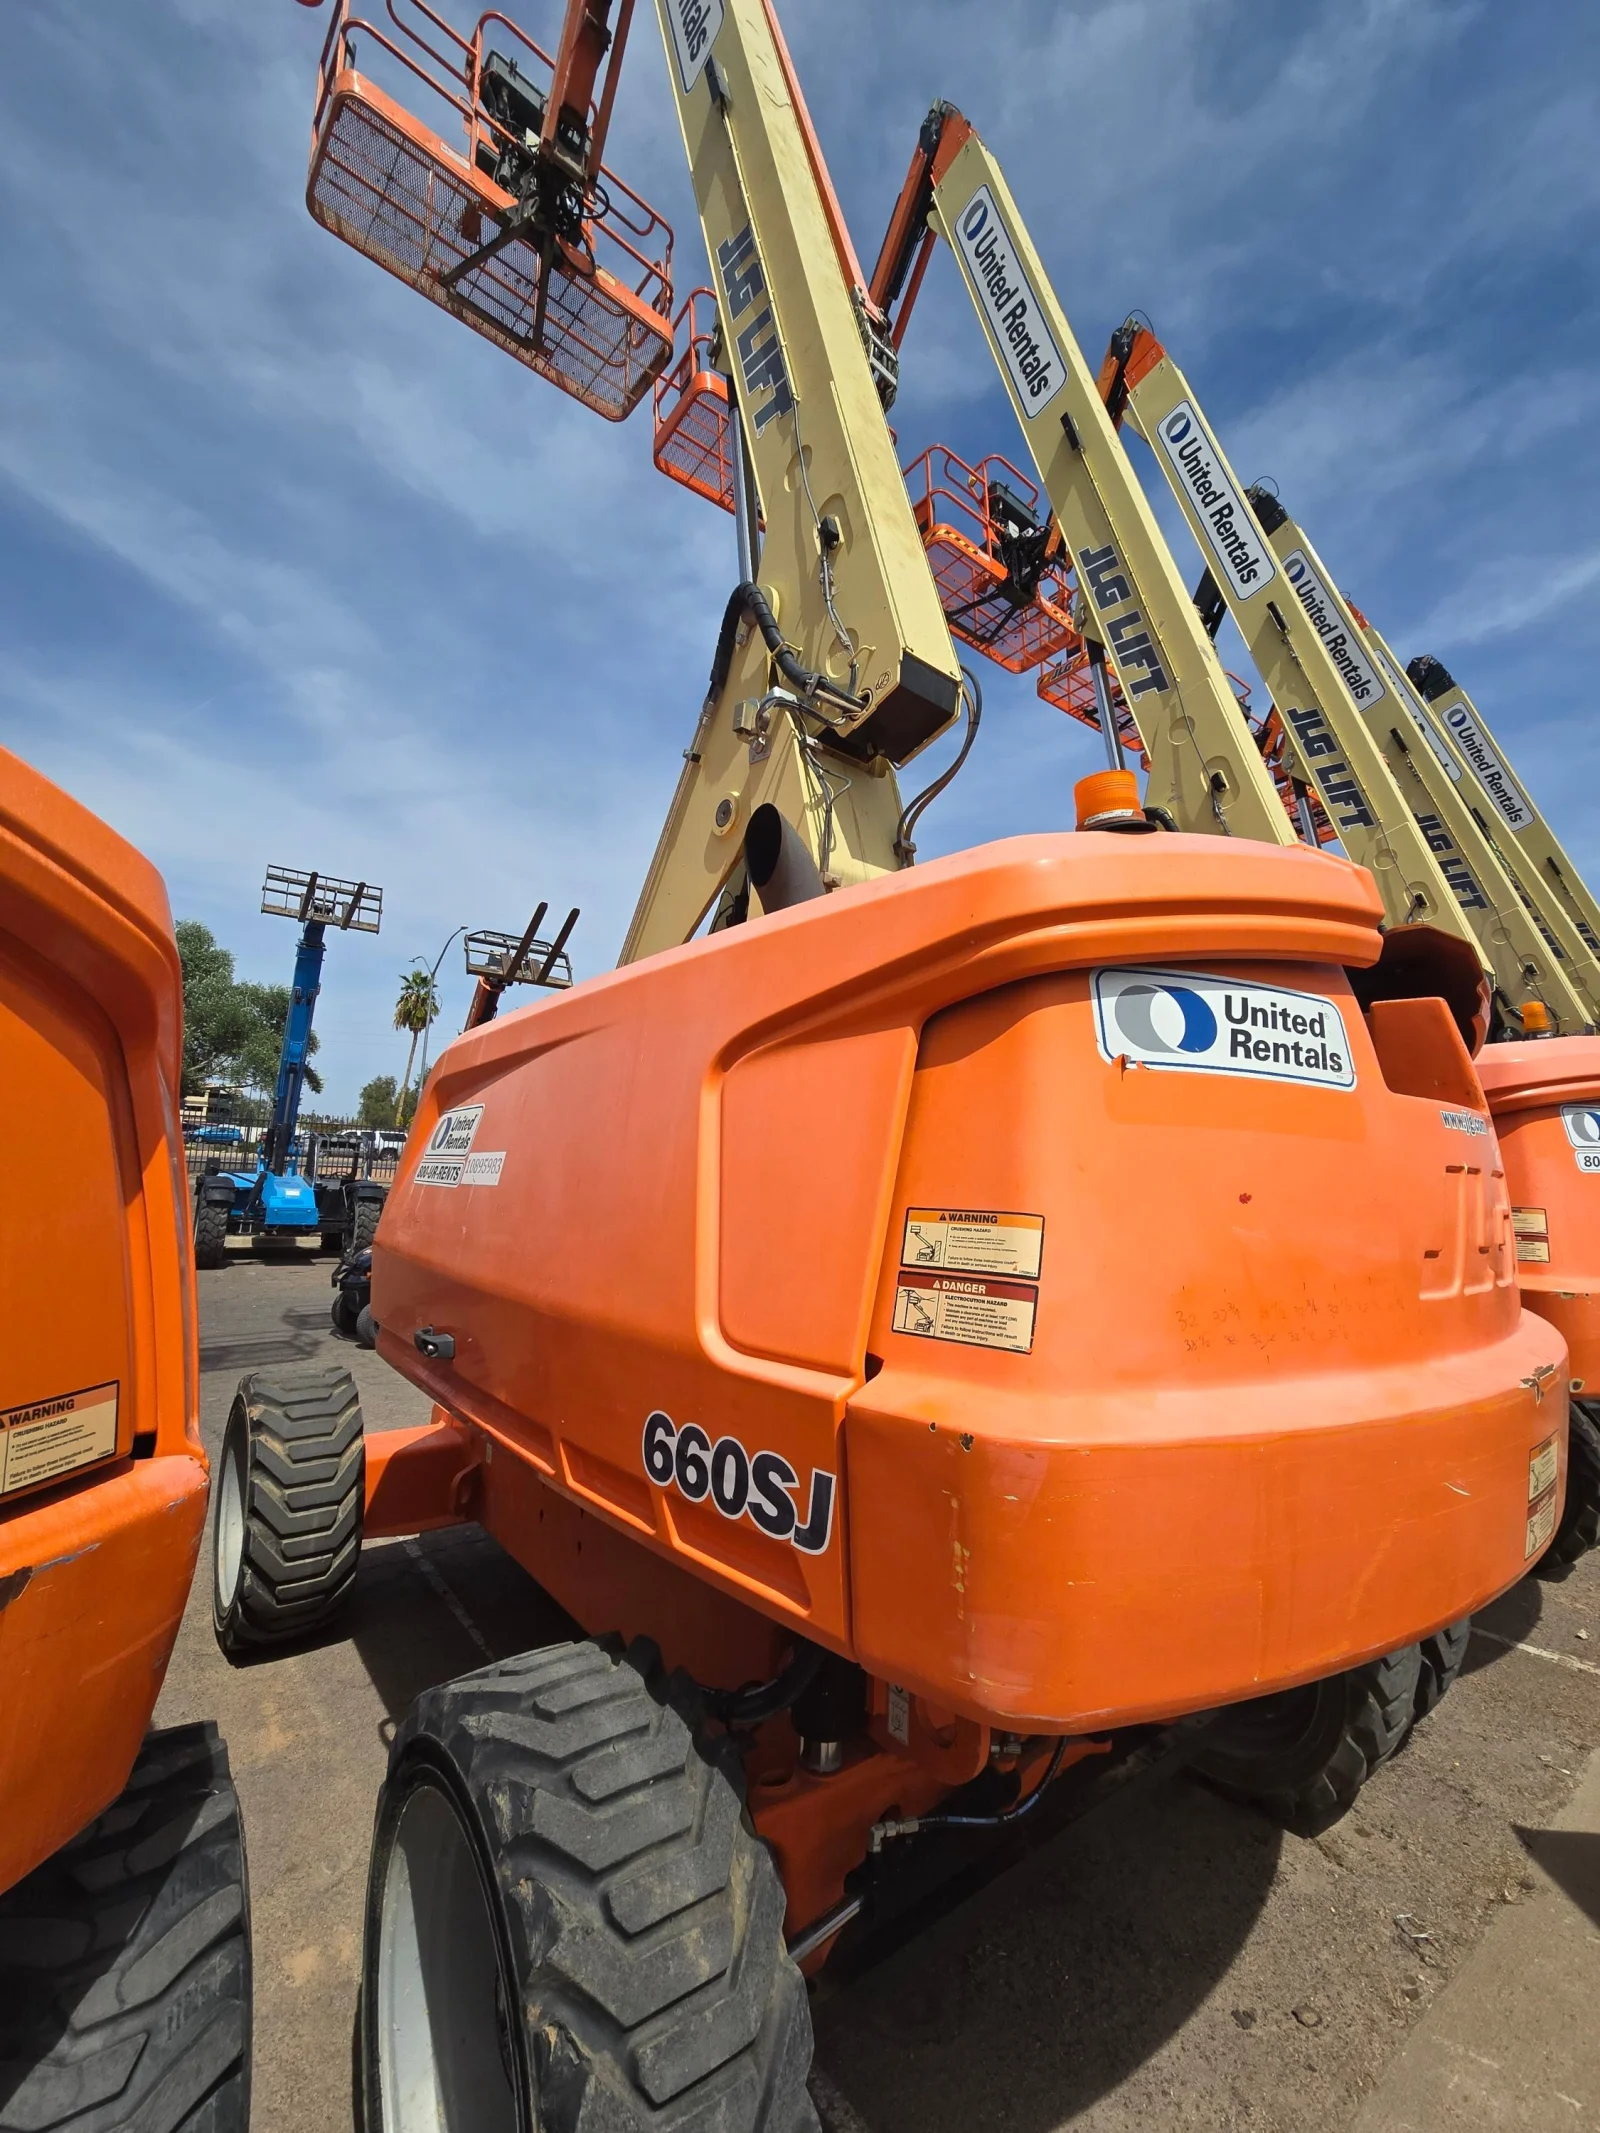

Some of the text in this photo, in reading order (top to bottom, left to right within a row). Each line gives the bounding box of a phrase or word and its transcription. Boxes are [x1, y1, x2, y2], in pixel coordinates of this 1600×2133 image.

[716, 222, 794, 427] JLG LIFT
[974, 226, 1051, 397] United Rentals
[1178, 436, 1260, 585] United Rentals
[1077, 544, 1170, 696] JLG LIFT
[1295, 579, 1372, 700] United Rentals
[1051, 662, 1073, 680] JLG
[1285, 706, 1376, 829] JLG LIFT
[1457, 726, 1523, 823] United Rentals
[1412, 812, 1455, 853] JLG
[1438, 857, 1489, 910] LIFT
[1224, 994, 1326, 1039] United
[1230, 1028, 1343, 1073] Rentals
[443, 1132, 471, 1150] Rentals
[451, 1114, 478, 1132] United
[1441, 1110, 1486, 1135] www.jlg.com
[417, 1165, 461, 1182] 800-UR-RENTS
[949, 1213, 998, 1224] WARNING
[942, 1280, 986, 1294] DANGER
[945, 1295, 1008, 1307] ELECTROCUTION HAZARD
[9, 1398, 75, 1426] WARNING
[12, 1418, 68, 1438] CRUSHING HAZARD
[642, 1410, 836, 1555] 660SJ
